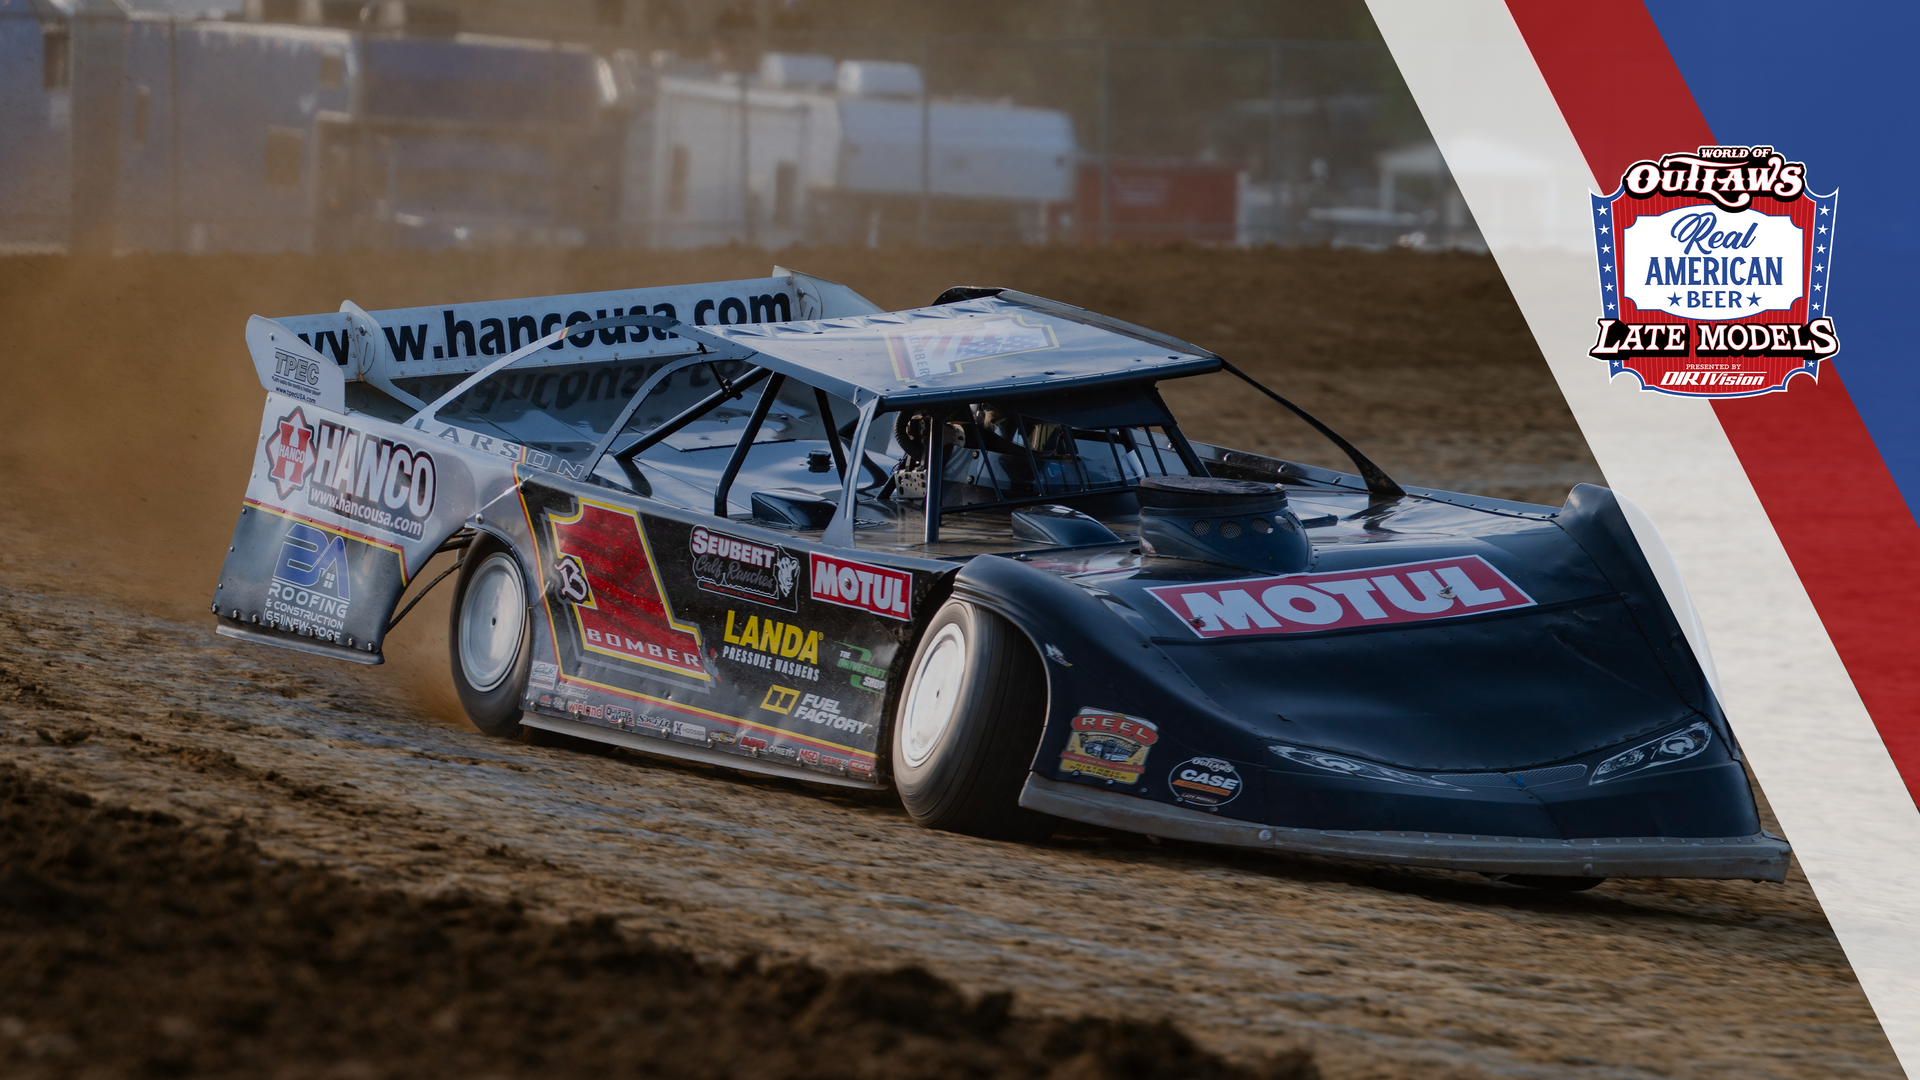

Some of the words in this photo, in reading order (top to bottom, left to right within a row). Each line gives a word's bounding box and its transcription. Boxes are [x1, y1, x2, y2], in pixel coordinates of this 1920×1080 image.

[275, 351, 320, 385] TPEC
[908, 332, 930, 376] BOMBER
[275, 387, 316, 404] www.tpecUSA.com
[278, 443, 306, 464] HANCO
[414, 418, 584, 479] LARSON
[312, 424, 434, 518] HANCO
[311, 487, 422, 536] www.hancousa.com
[692, 528, 775, 569] SEUBERT
[696, 554, 722, 578] Calf
[727, 561, 774, 589] Ranches
[814, 561, 906, 613] MOTUL
[268, 582, 349, 619] ROOFING
[551, 500, 708, 678] 1
[1181, 566, 1506, 632] MOTUL
[265, 598, 272, 608] &
[274, 601, 344, 630] CONSTRUCTION
[586, 628, 700, 667] BOMBER
[722, 645, 773, 670] PRESSURE
[774, 658, 820, 682] WASHERS
[840, 650, 851, 659] THE
[837, 658, 887, 679] DRIVESHAFT
[863, 676, 886, 690] SHOP
[568, 700, 603, 718] wieland
[801, 693, 841, 714] FUEL
[740, 736, 767, 750] ARP
[1081, 717, 1149, 739] REEL
[800, 749, 819, 761] MSD
[1076, 763, 1122, 776] HISTORIC
[1180, 769, 1240, 790] CASE
